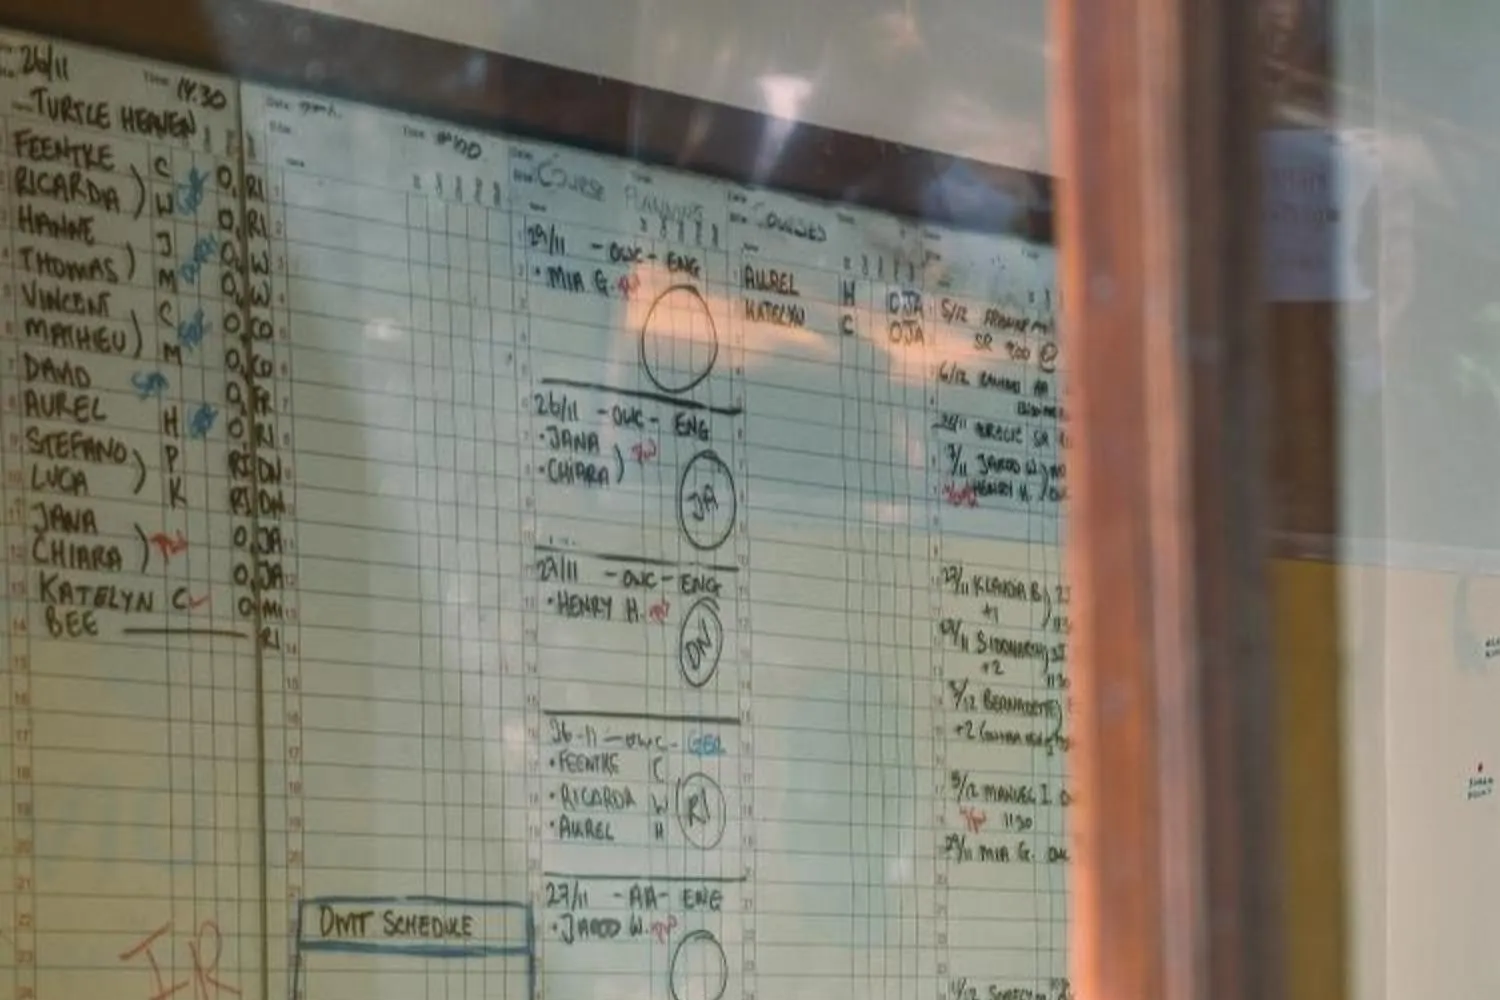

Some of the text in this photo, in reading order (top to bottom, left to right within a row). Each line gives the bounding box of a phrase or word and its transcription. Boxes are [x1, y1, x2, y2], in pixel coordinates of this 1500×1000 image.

[21, 45, 69, 81] 26/11
[31, 86, 112, 130] TURTLE
[18, 205, 95, 246] HANNE
[20, 246, 120, 286] THOMAS
[548, 265, 586, 293] MIA
[22, 280, 112, 318] VINCENT
[24, 392, 108, 424] AUREL
[164, 405, 180, 438] H
[674, 413, 711, 442] ENG
[25, 426, 129, 466] STEFANO
[548, 424, 600, 451] JANA
[30, 464, 188, 509] LUCA K
[29, 502, 99, 536] JANA
[32, 532, 123, 572] CHIARA
[39, 571, 154, 616] KATELYN
[680, 572, 723, 595] ENG
[45, 605, 99, 639] BEE
[557, 597, 613, 621] HENRY
[383, 910, 474, 939] SCHEDULE
